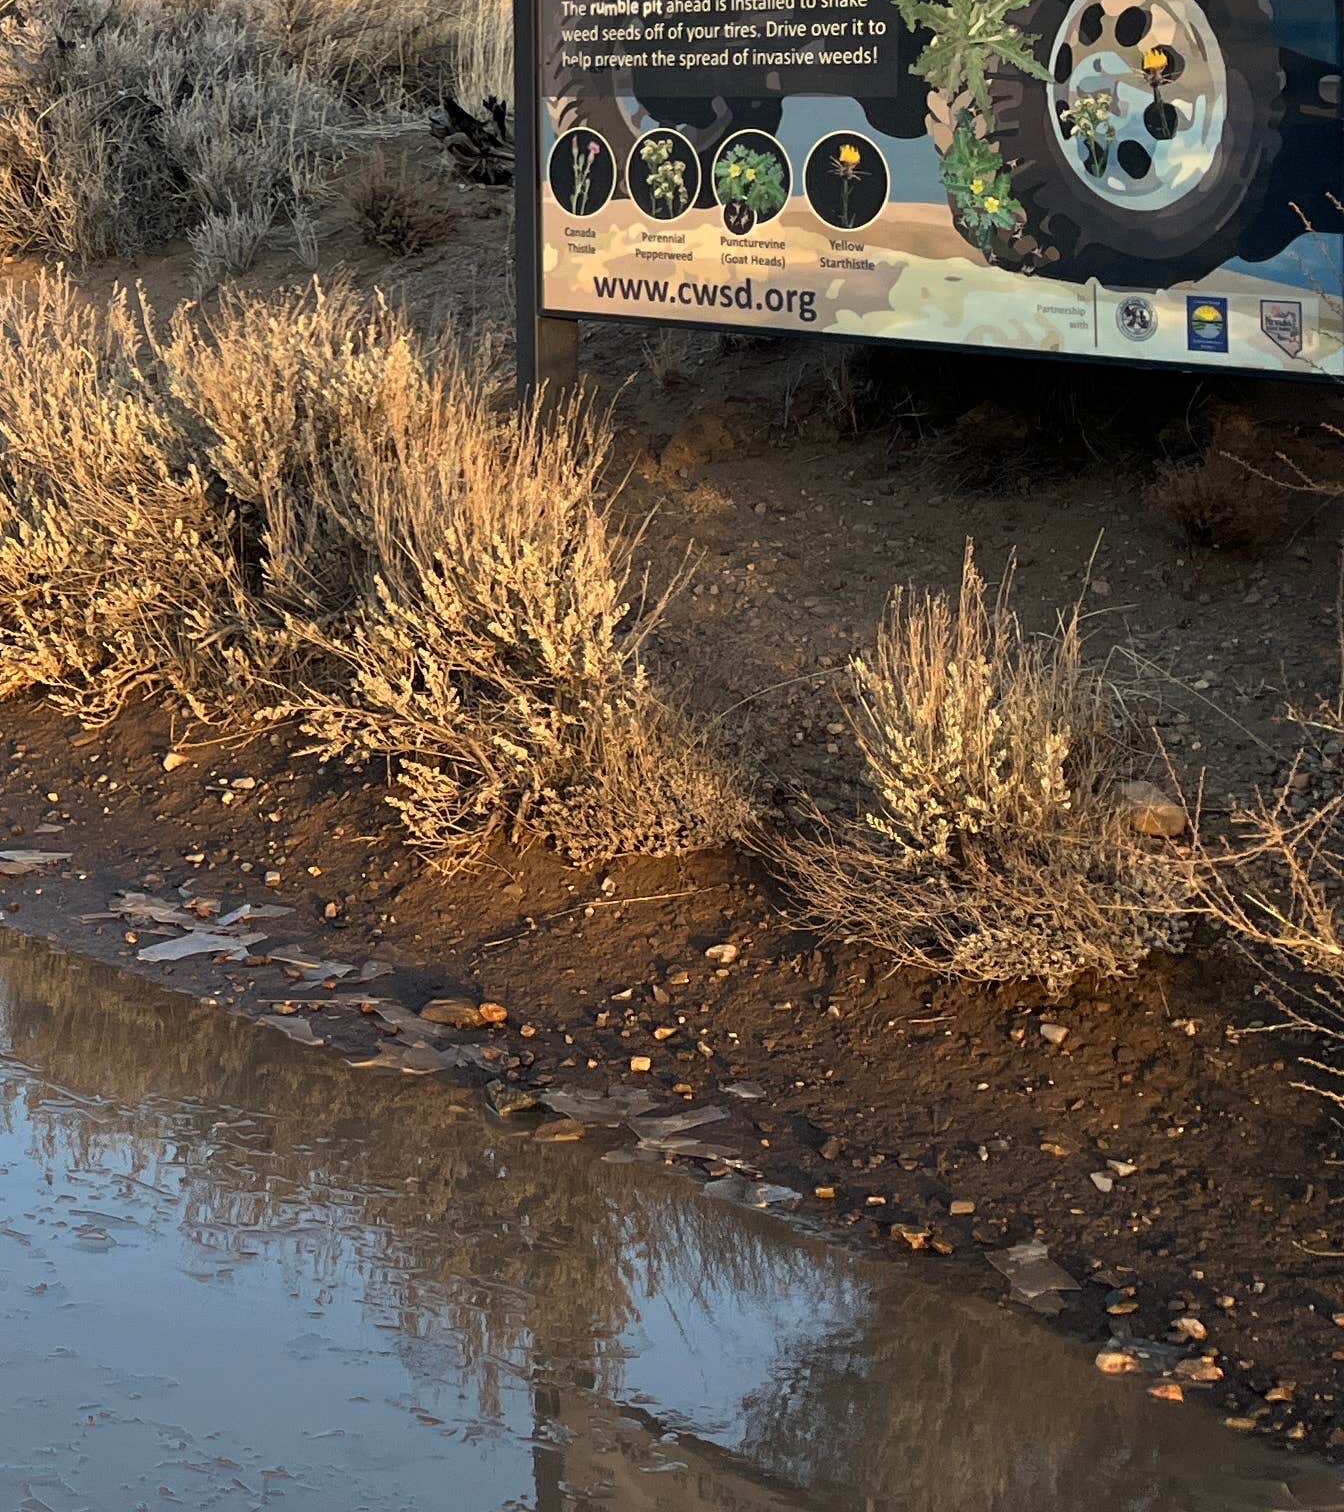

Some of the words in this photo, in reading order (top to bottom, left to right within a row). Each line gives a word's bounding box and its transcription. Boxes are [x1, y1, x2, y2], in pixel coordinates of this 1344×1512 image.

[561, 1, 586, 16] The
[561, 25, 598, 42] weed
[602, 24, 641, 41] seeds
[644, 23, 664, 40] off
[668, 22, 684, 39] of
[687, 26, 720, 43] your
[724, 22, 761, 38] tires.
[766, 20, 806, 37] Drive
[811, 22, 847, 36] over
[852, 19, 864, 35] it
[868, 20, 886, 35] to
[561, 51, 592, 70] help
[595, 52, 648, 67] prevent
[651, 49, 675, 66] the
[679, 48, 729, 70] spread
[733, 48, 749, 65] of
[752, 48, 814, 65] invasive
[818, 46, 878, 65] weeds!
[564, 227, 596, 238] Canada
[641, 232, 686, 244] Perennial
[567, 243, 596, 254] Thistle
[720, 236, 786, 250] Puncturevine
[830, 240, 865, 251] Yellow
[635, 248, 693, 262] Pepperweed
[721, 253, 748, 265] (Goat
[751, 256, 786, 270] Heads)
[820, 257, 876, 271] Starthistle
[593, 276, 817, 322] www.cwsd.org
[1037, 304, 1086, 317] Partnership
